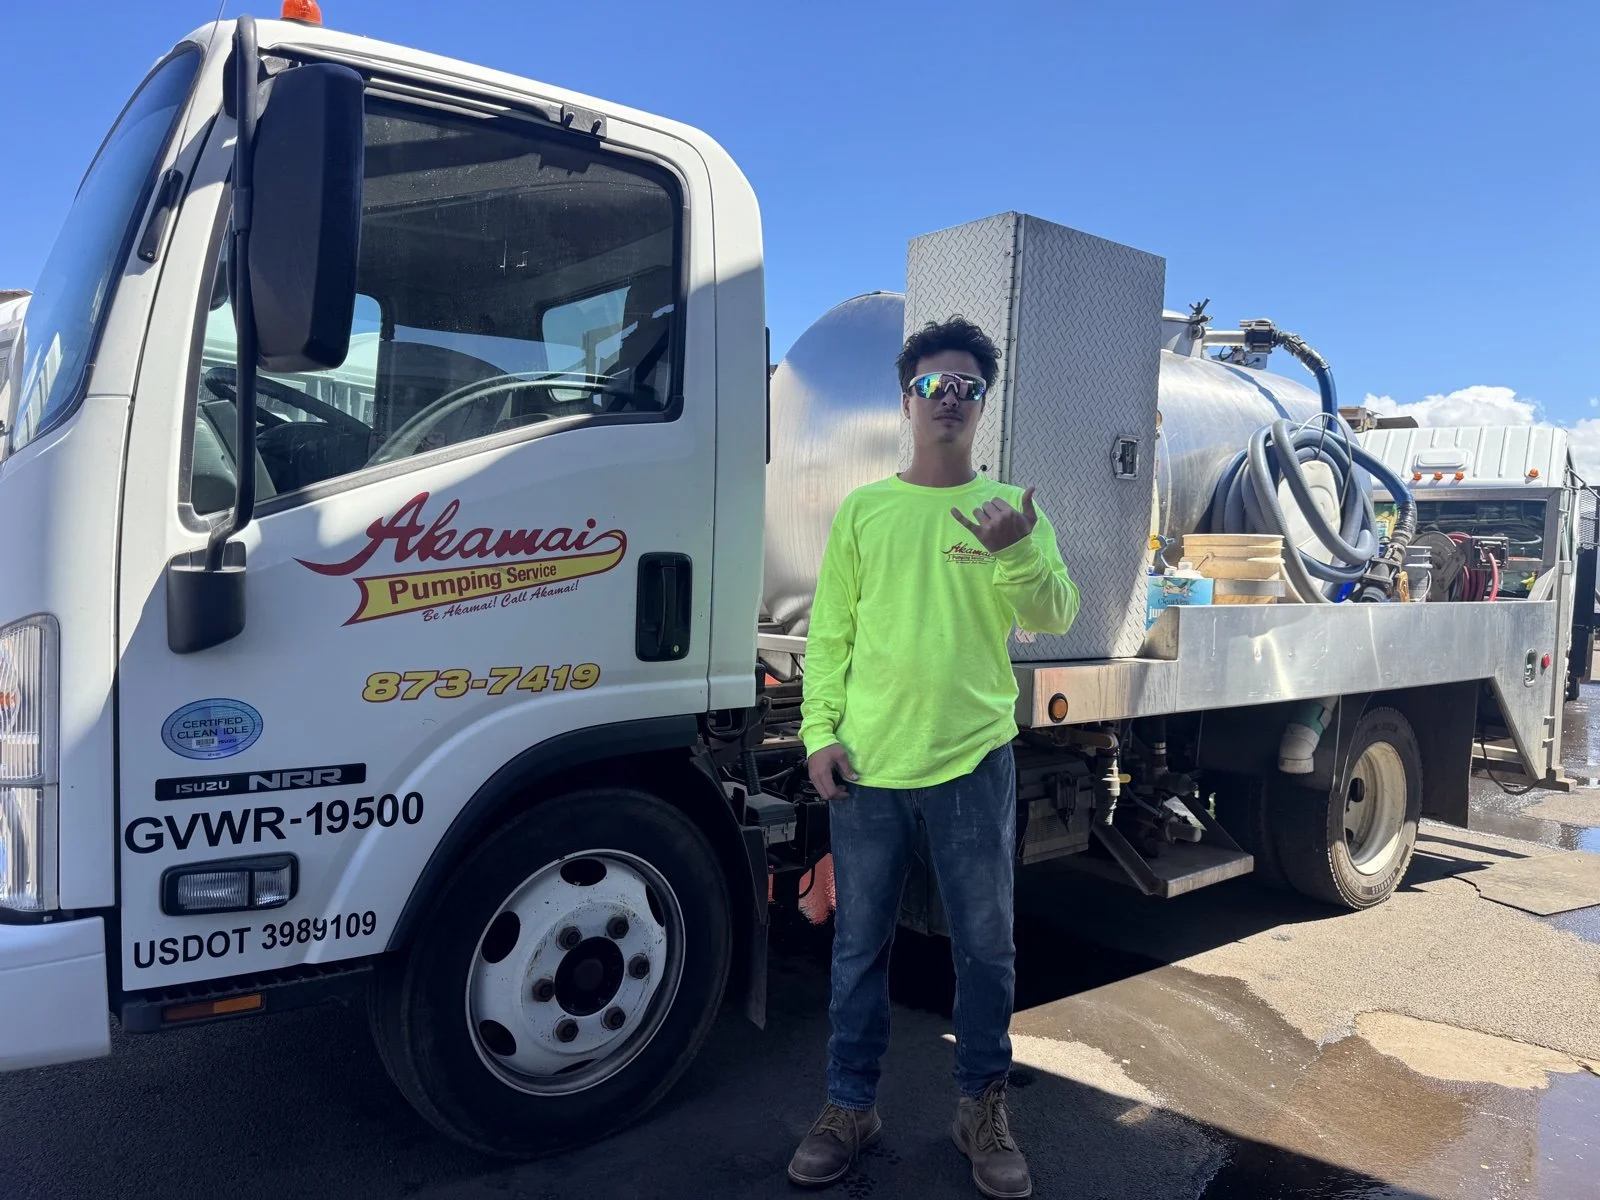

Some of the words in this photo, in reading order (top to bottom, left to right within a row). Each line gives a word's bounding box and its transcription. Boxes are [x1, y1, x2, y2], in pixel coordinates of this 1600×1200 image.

[292, 491, 622, 576] Akamai
[388, 570, 502, 604] Pumping
[507, 563, 557, 584] Service
[422, 608, 441, 622] Be
[442, 596, 497, 620] Akamai!
[500, 591, 528, 608] Call
[529, 580, 579, 600] Akamai!
[362, 663, 600, 703] 873-7419
[177, 728, 218, 740] CLEAN
[223, 725, 249, 735] IDLE
[182, 716, 243, 729] CERTIFIED
[175, 780, 230, 794] ISUZU
[248, 767, 342, 791] NRR
[124, 791, 424, 854] GVWR-19500
[133, 926, 251, 969] USDOT
[261, 910, 377, 950] 3989109
